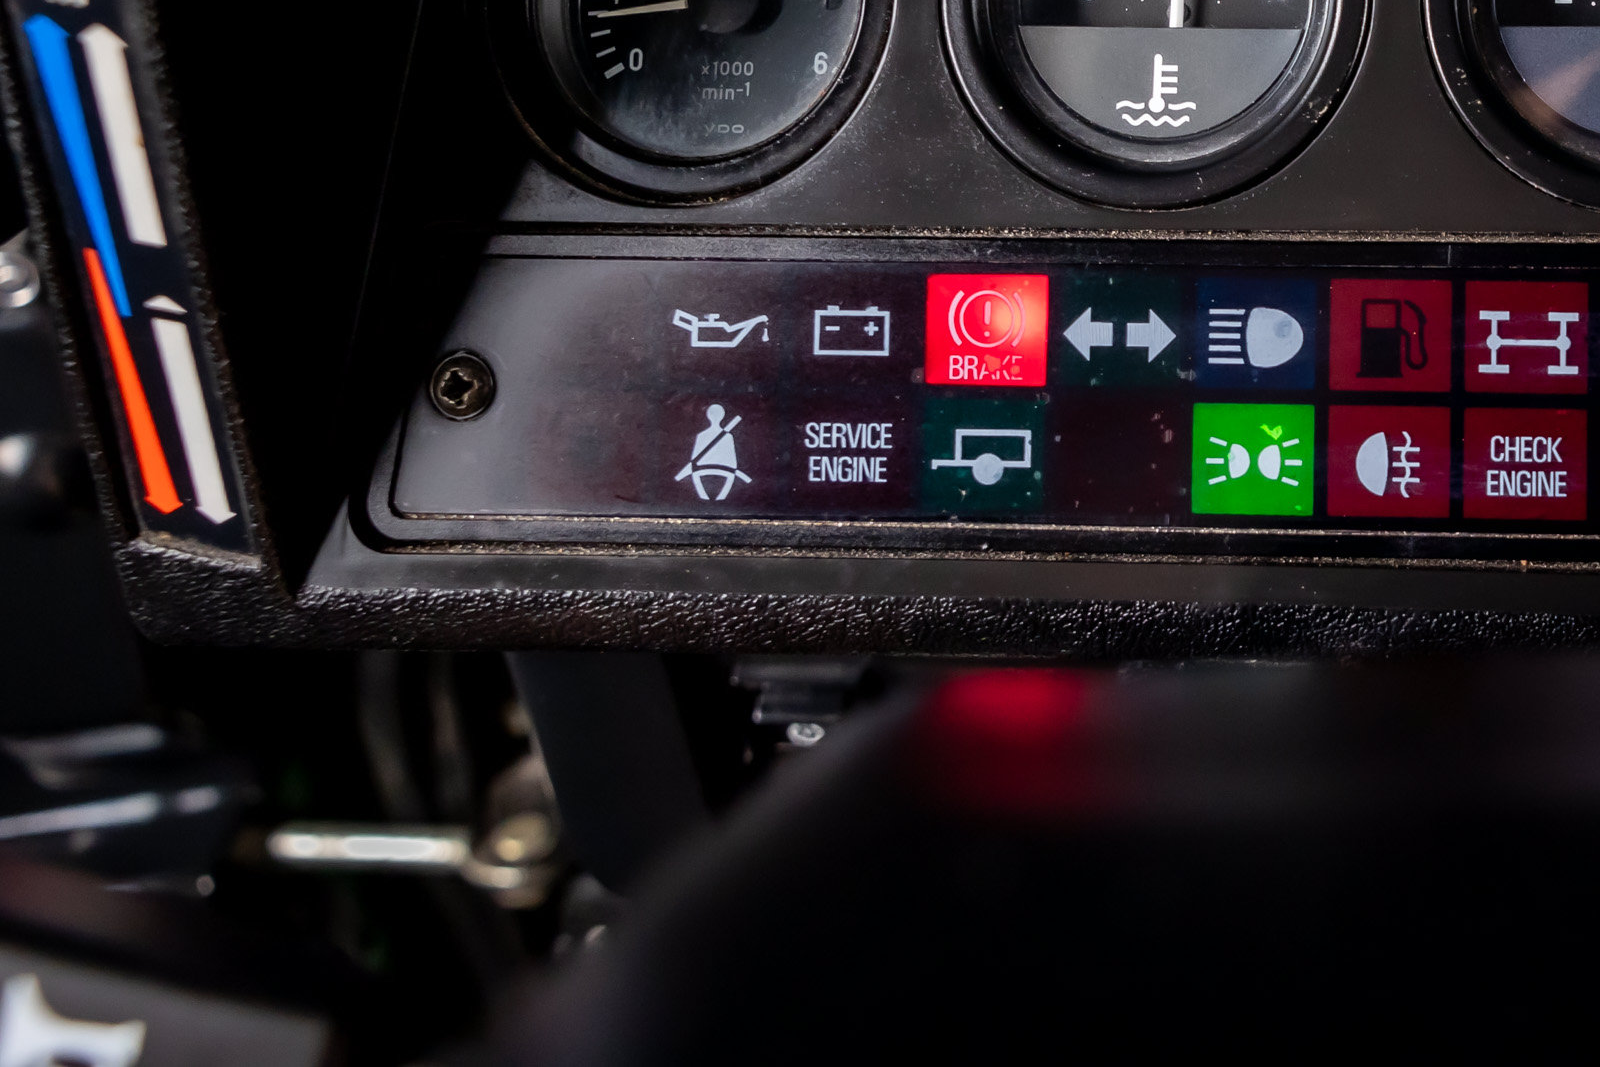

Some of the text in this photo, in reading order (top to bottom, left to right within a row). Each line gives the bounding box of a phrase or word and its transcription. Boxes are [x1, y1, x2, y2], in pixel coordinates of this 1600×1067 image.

[629, 48, 644, 71] 0
[701, 61, 754, 76] x1000
[814, 52, 828, 75] 6
[948, 355, 1023, 381] BRAKE
[805, 423, 893, 450] SERVICE
[1489, 435, 1562, 463] CHECK
[808, 457, 887, 483] ENGINE
[1486, 471, 1567, 498] ENGINE
